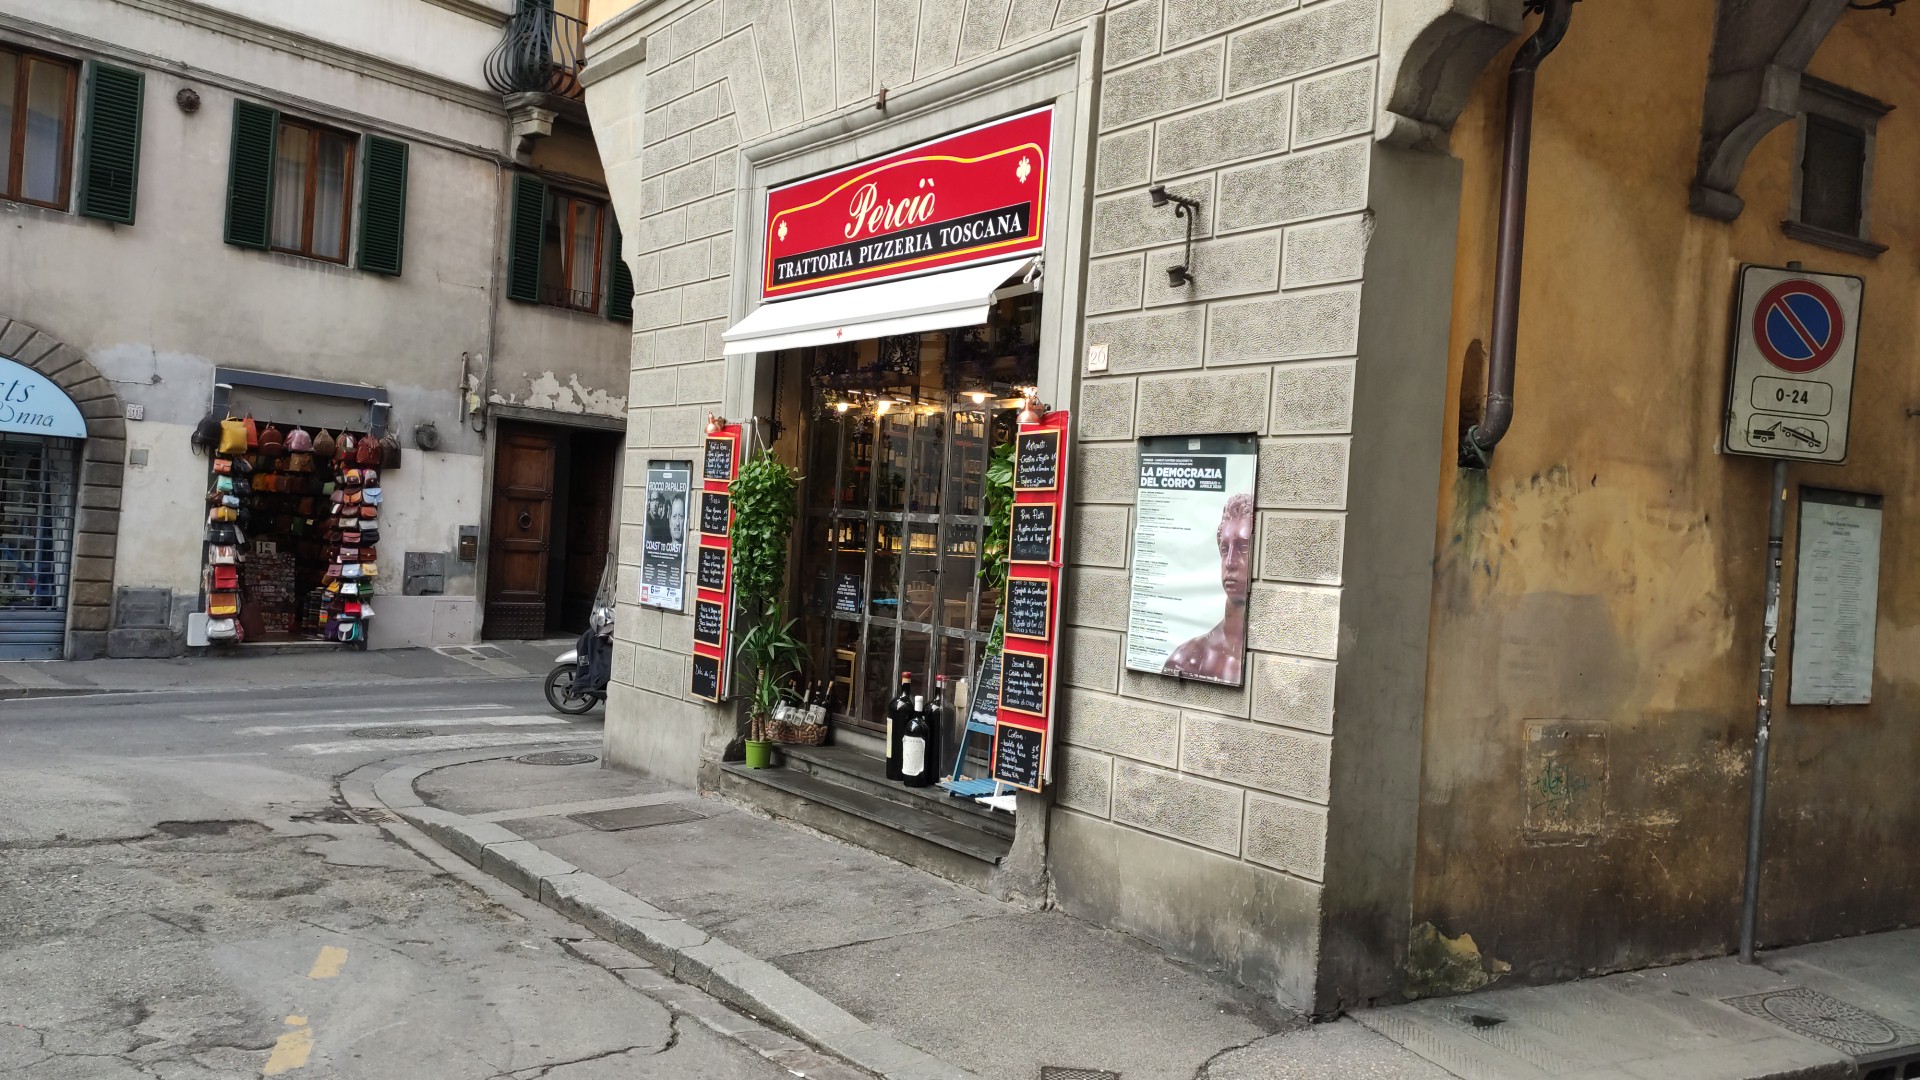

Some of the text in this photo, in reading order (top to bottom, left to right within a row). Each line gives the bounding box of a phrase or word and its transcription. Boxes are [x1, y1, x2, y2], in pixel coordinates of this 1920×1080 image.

[844, 177, 935, 238] Perciò
[777, 211, 1022, 280] TRATTORIA PIZZERIA TOSCANA
[1775, 389, 1809, 405] 0-24
[1141, 467, 1222, 479] LA DEMOCRAZIA
[649, 481, 687, 492] ROCCO PAPALEO
[1140, 477, 1195, 488] DEL CORPO
[646, 540, 682, 553] COAST TO COAST
[651, 585, 655, 594] 6
[666, 587, 671, 597] 7
